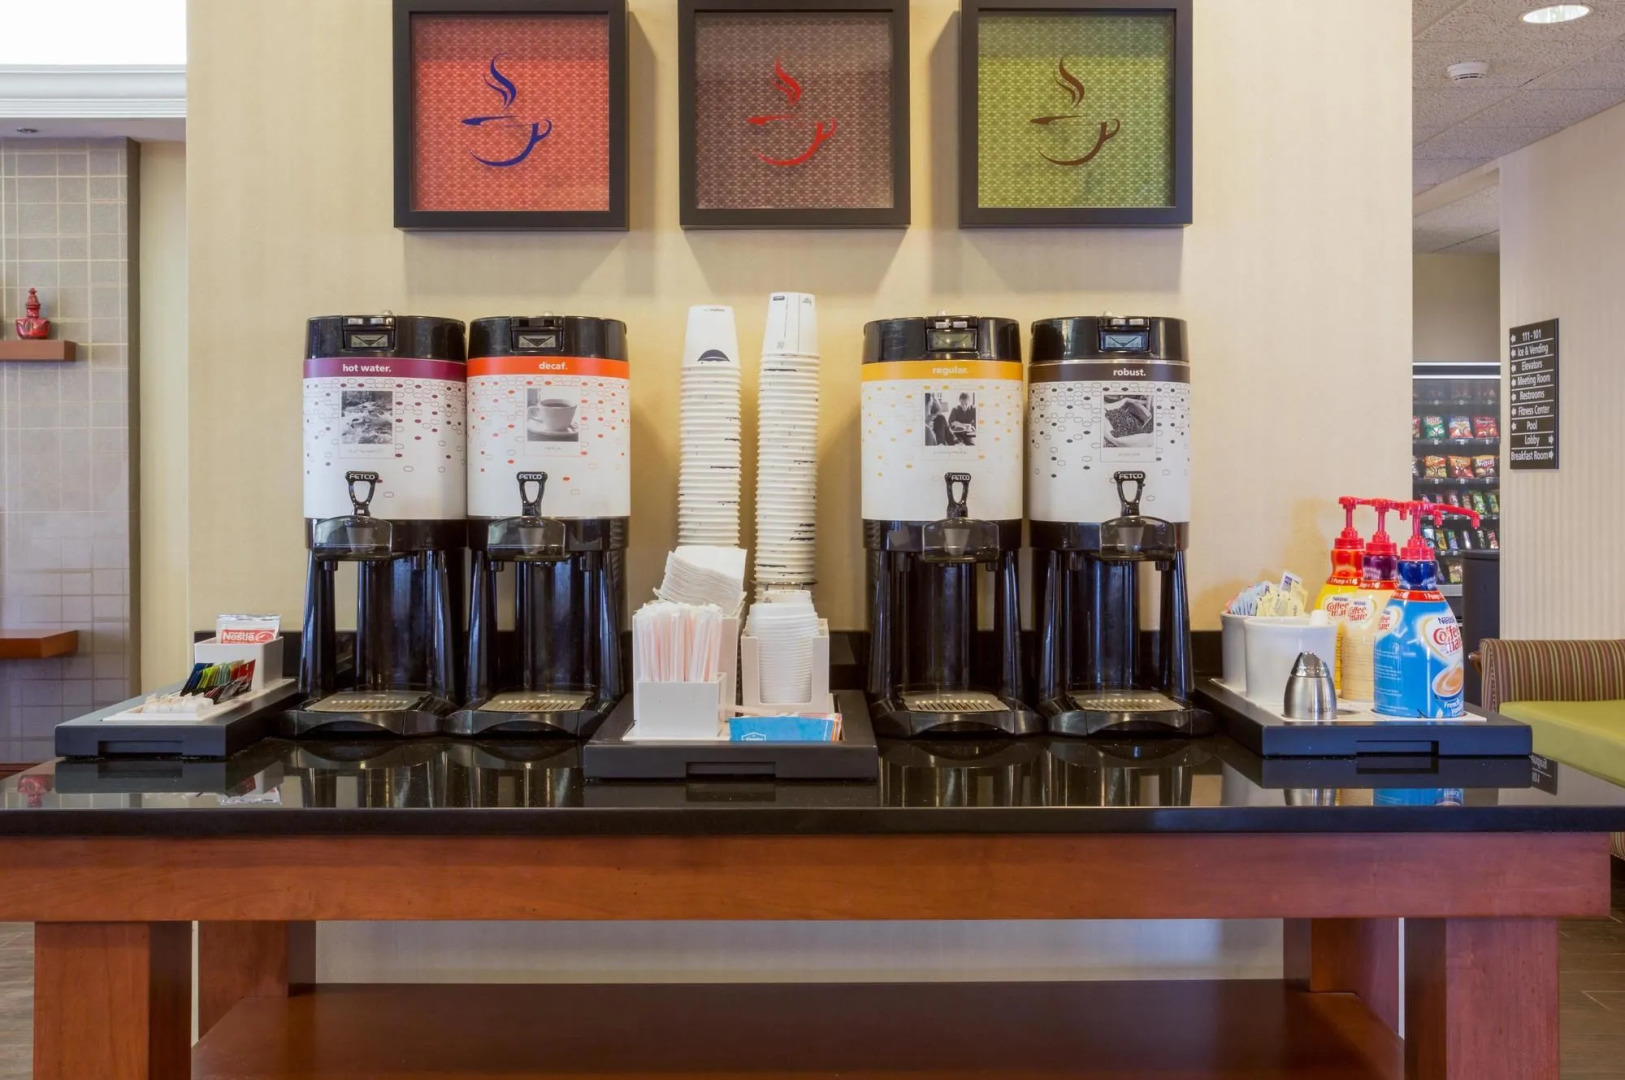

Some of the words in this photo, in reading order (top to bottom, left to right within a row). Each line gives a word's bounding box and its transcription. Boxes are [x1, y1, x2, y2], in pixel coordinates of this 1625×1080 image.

[1530, 343, 1549, 355] Vending
[342, 363, 359, 373] hot
[361, 364, 392, 373] water.
[538, 361, 568, 371] decaf.
[932, 365, 969, 375] regular.
[1521, 360, 1543, 371] Elevators
[1113, 367, 1147, 377] robust.
[1517, 374, 1536, 387] Meeting
[1536, 373, 1551, 384] Room
[1520, 390, 1545, 400] Restrooms
[1518, 406, 1534, 416] Fitness
[1534, 405, 1550, 415] Center
[1526, 420, 1538, 430] Pool
[1524, 434, 1540, 447] Lobby
[1510, 450, 1533, 461] Breakfast
[1533, 450, 1549, 460] Room
[1327, 602, 1350, 612] Coffee
